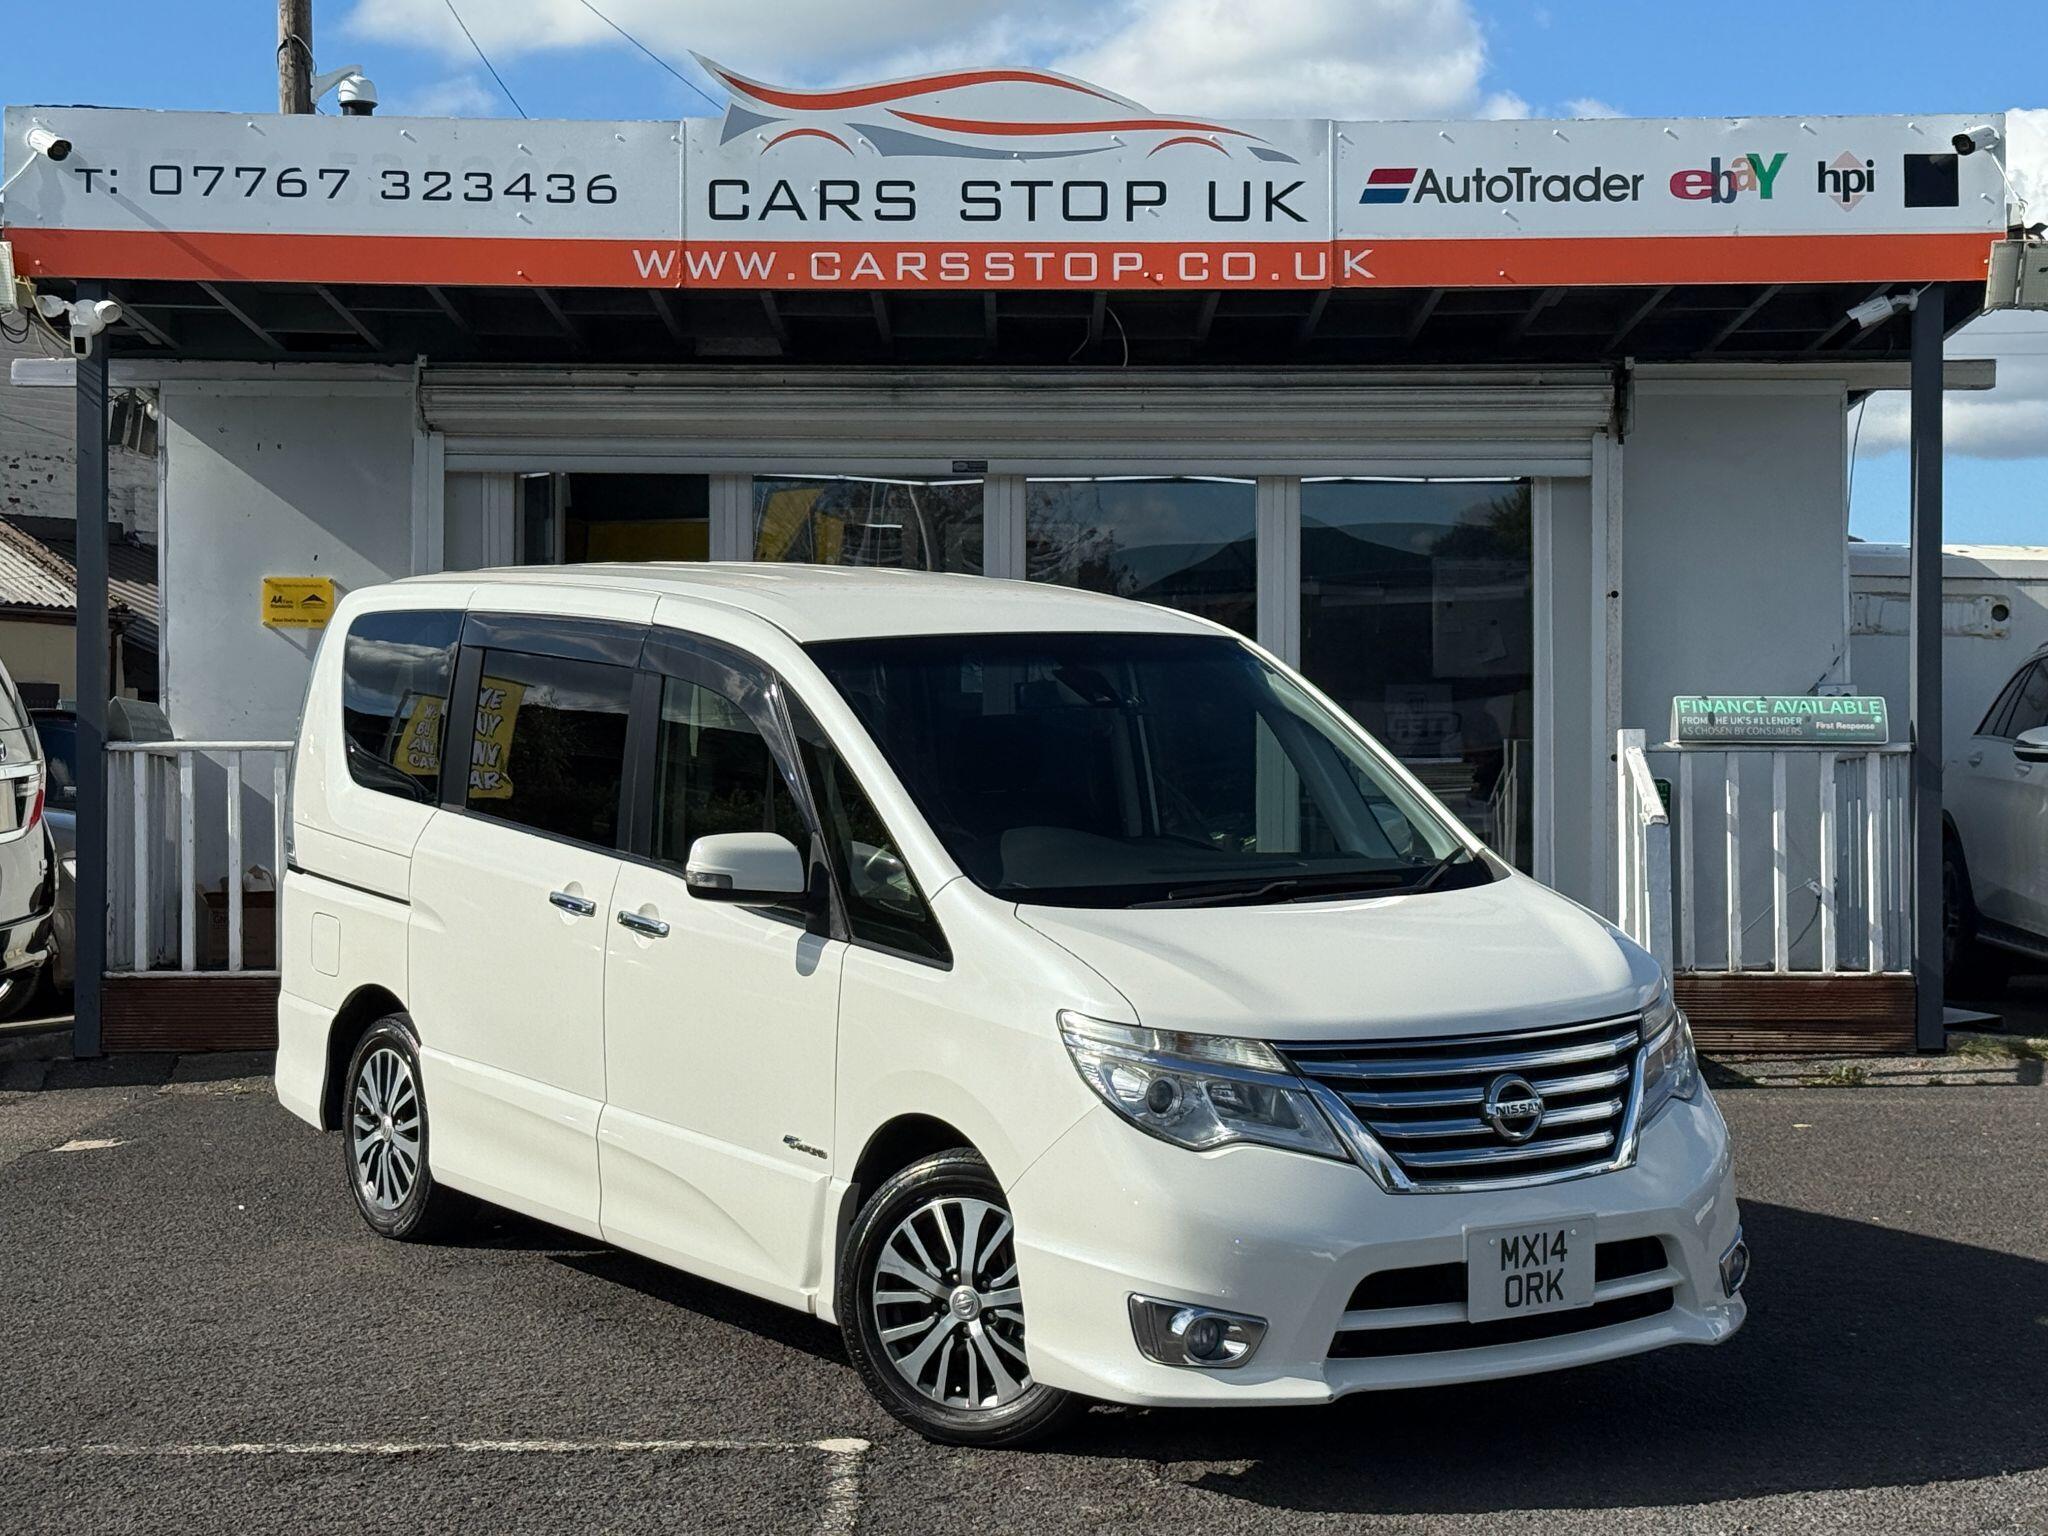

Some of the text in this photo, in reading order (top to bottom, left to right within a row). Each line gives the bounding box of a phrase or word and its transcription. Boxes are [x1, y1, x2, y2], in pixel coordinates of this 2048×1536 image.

[75, 165, 618, 205] T: 07767 323436
[1413, 166, 1645, 204] AutoTrader
[1818, 159, 1875, 203] hpi
[708, 179, 1308, 223] CARS STOP UK
[632, 249, 1376, 282] WWW.CARSSTOP.CO.UK
[1680, 700, 1882, 715] FINANCE AVAILABLE
[476, 711, 503, 737] UY
[1681, 716, 1708, 725] FROM
[1767, 716, 1803, 726] LENDER
[1694, 727, 1731, 735] CHOSEN
[1734, 727, 1745, 735] BY
[1746, 727, 1804, 736] CONSUMERS
[1836, 722, 1876, 731] Response
[472, 741, 501, 767] NY
[469, 770, 503, 791] AR
[1496, 1102, 1542, 1115] NISSAN
[1500, 1229, 1568, 1272] MX14
[1504, 1268, 1564, 1308] ORK
